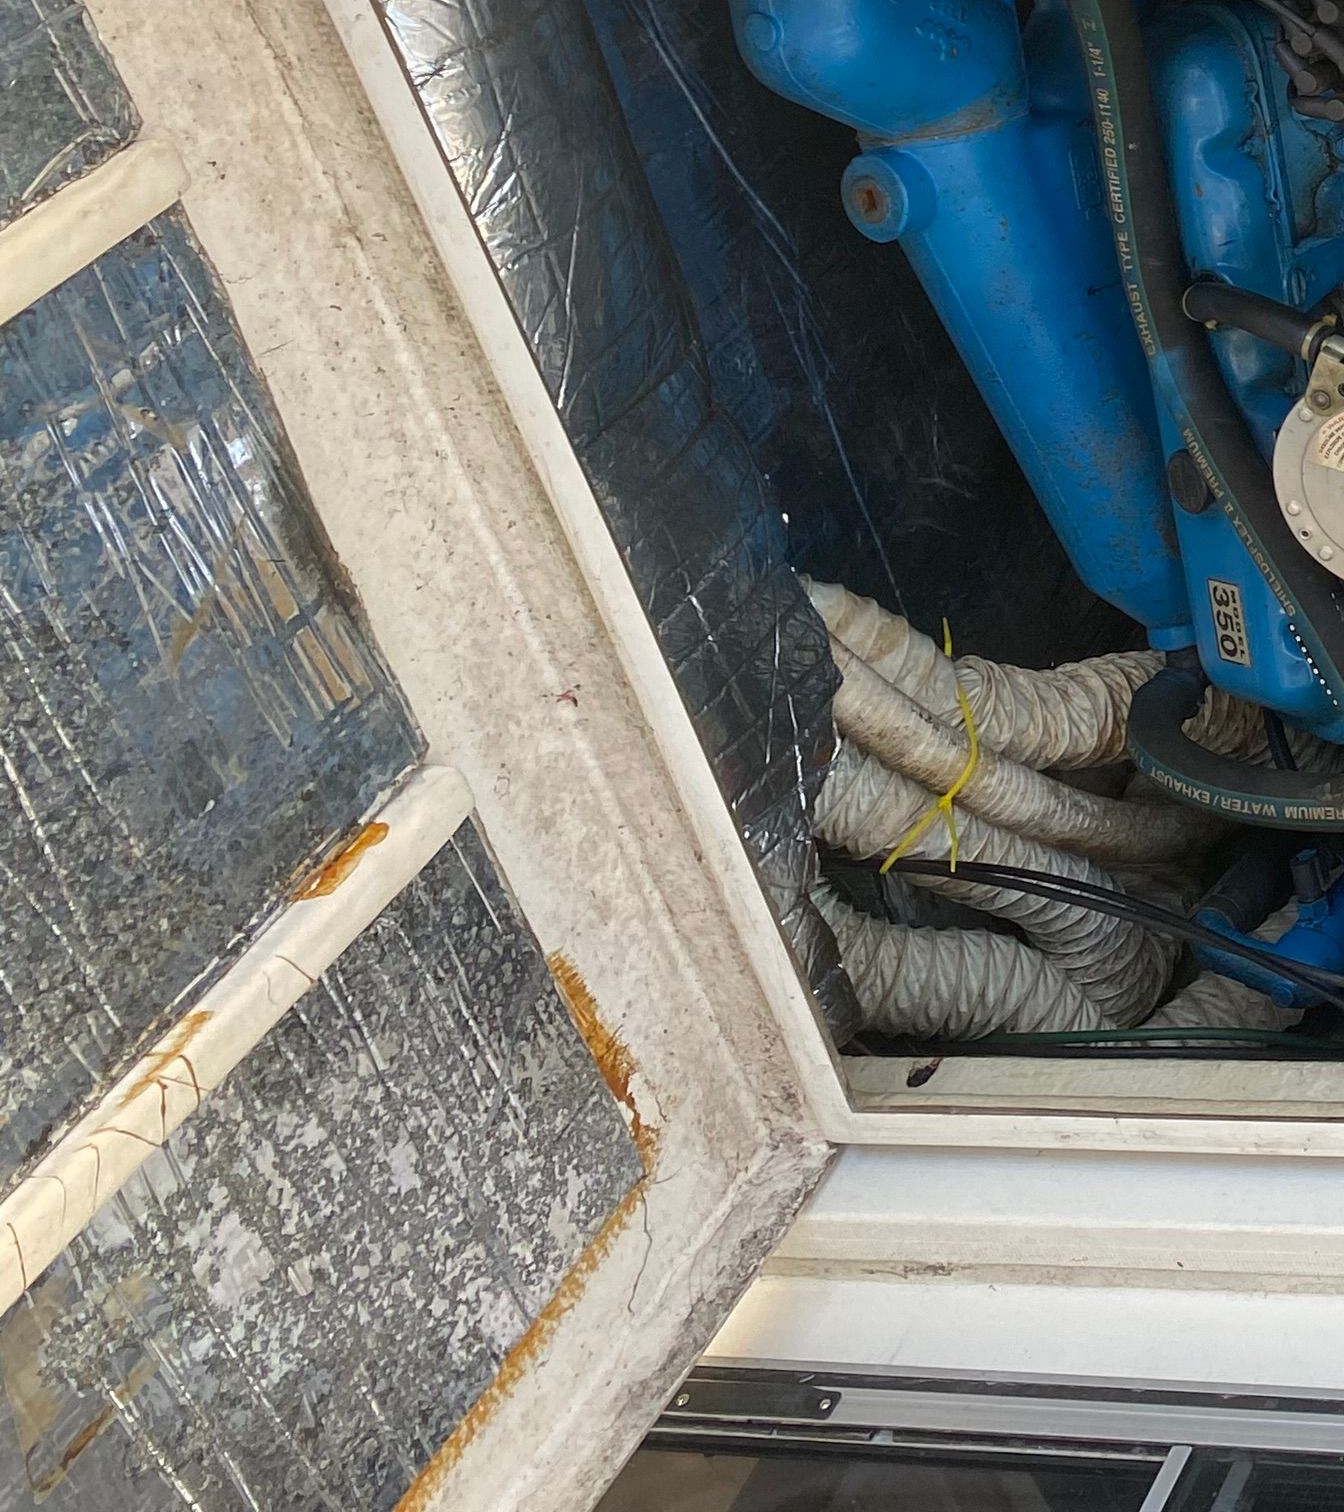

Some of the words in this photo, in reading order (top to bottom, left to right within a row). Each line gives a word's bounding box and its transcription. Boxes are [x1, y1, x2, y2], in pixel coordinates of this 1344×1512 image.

[1088, 41, 1105, 78] 1-1/4"
[1096, 88, 1115, 145] 250-1140
[1105, 148, 1126, 224] CERTIFIED
[1116, 230, 1133, 273] TYPE
[1126, 282, 1157, 355] EXHAUST
[1180, 427, 1226, 499] PREMIUM
[1231, 516, 1298, 618] SHIELDSFLEX
[1213, 586, 1238, 658] 350
[1231, 590, 1245, 659] MODEL
